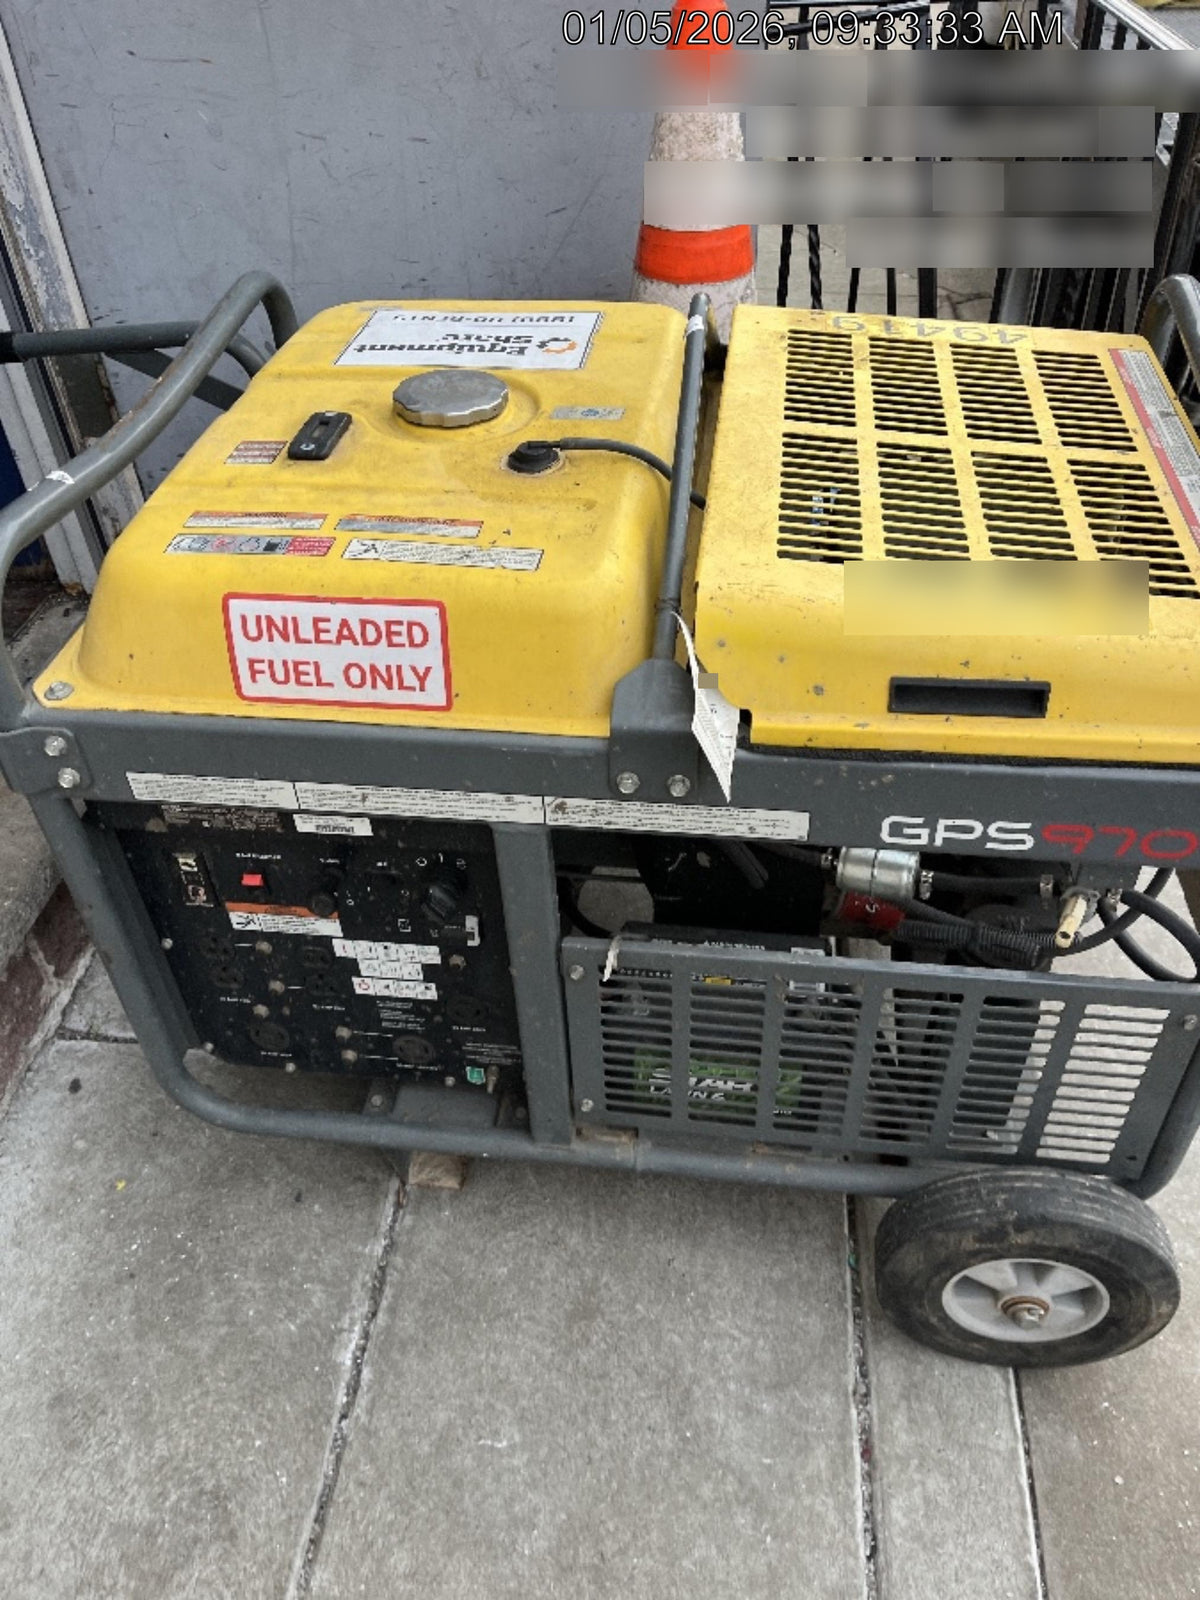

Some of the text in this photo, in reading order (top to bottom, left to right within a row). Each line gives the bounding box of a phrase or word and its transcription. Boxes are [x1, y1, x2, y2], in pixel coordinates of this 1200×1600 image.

[831, 315, 1028, 345] 49419
[239, 613, 430, 649] UNLEADED
[247, 657, 433, 693] FUEL ONLY
